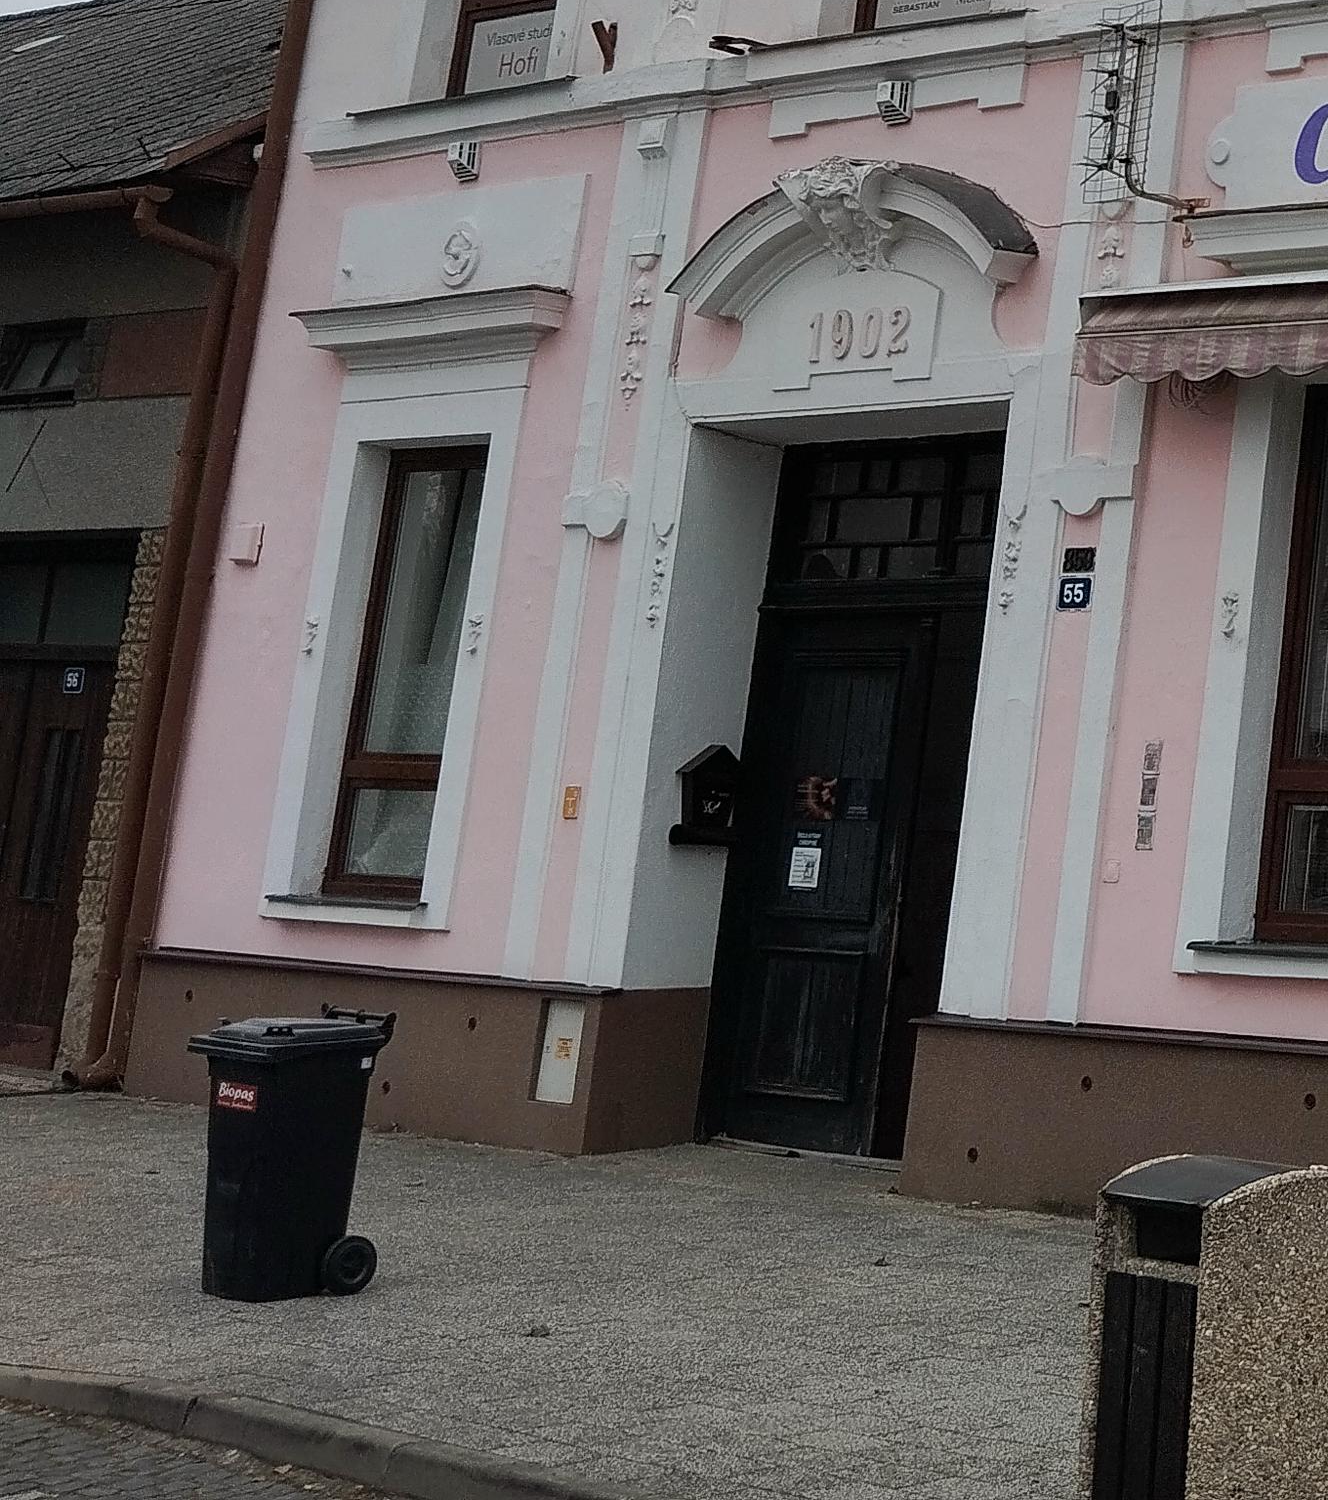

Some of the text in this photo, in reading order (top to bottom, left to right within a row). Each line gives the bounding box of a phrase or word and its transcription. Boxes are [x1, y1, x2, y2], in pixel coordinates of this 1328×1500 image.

[892, 1, 940, 14] SEBASTIAN
[486, 22, 553, 47] Vlasové studi
[498, 46, 539, 78] Hofi
[808, 305, 912, 364] 1902
[1063, 583, 1085, 604] 55
[66, 672, 79, 688] 56
[218, 1082, 255, 1102] Biopas
